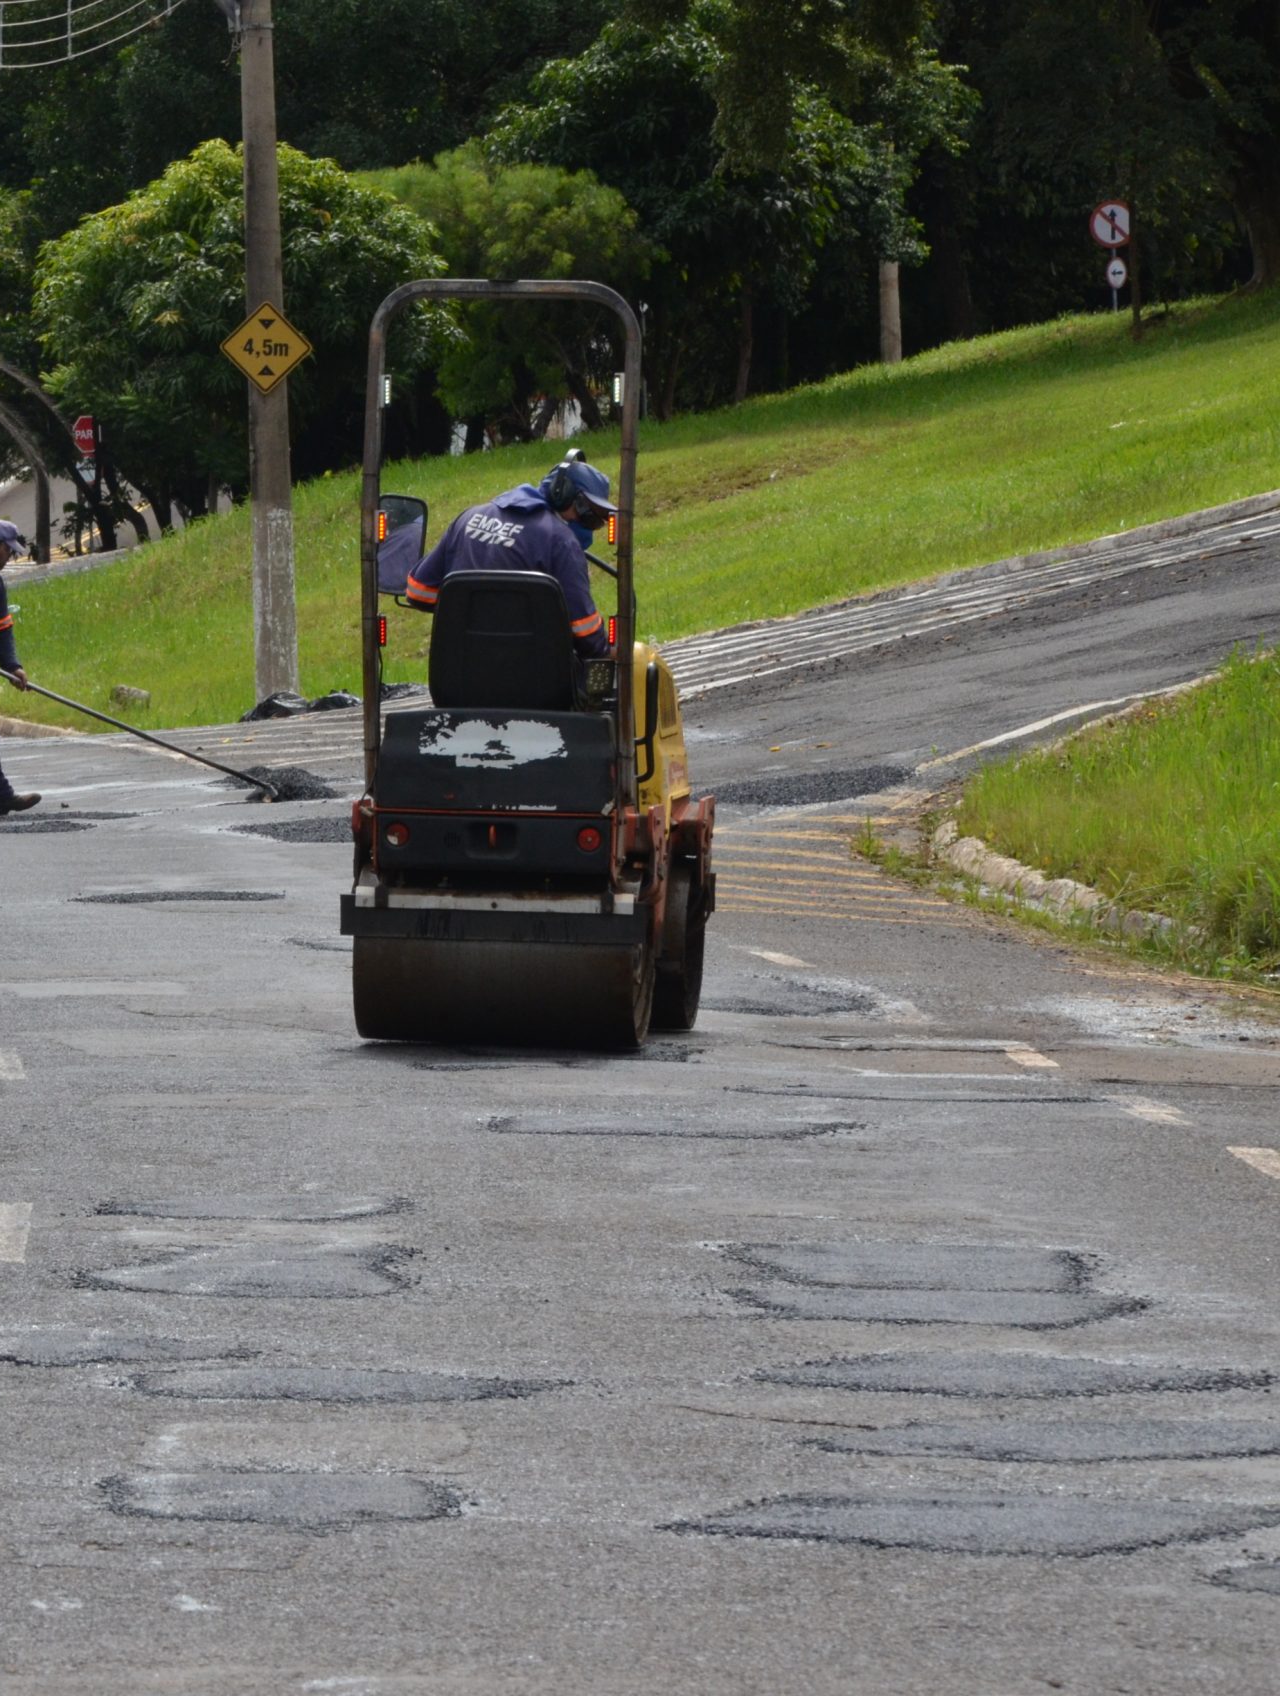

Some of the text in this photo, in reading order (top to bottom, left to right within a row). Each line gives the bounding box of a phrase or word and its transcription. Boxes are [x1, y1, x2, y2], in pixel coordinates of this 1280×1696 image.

[243, 338, 289, 358] 4,5m
[75, 429, 94, 440] PAR
[467, 513, 525, 537] EMDEF
